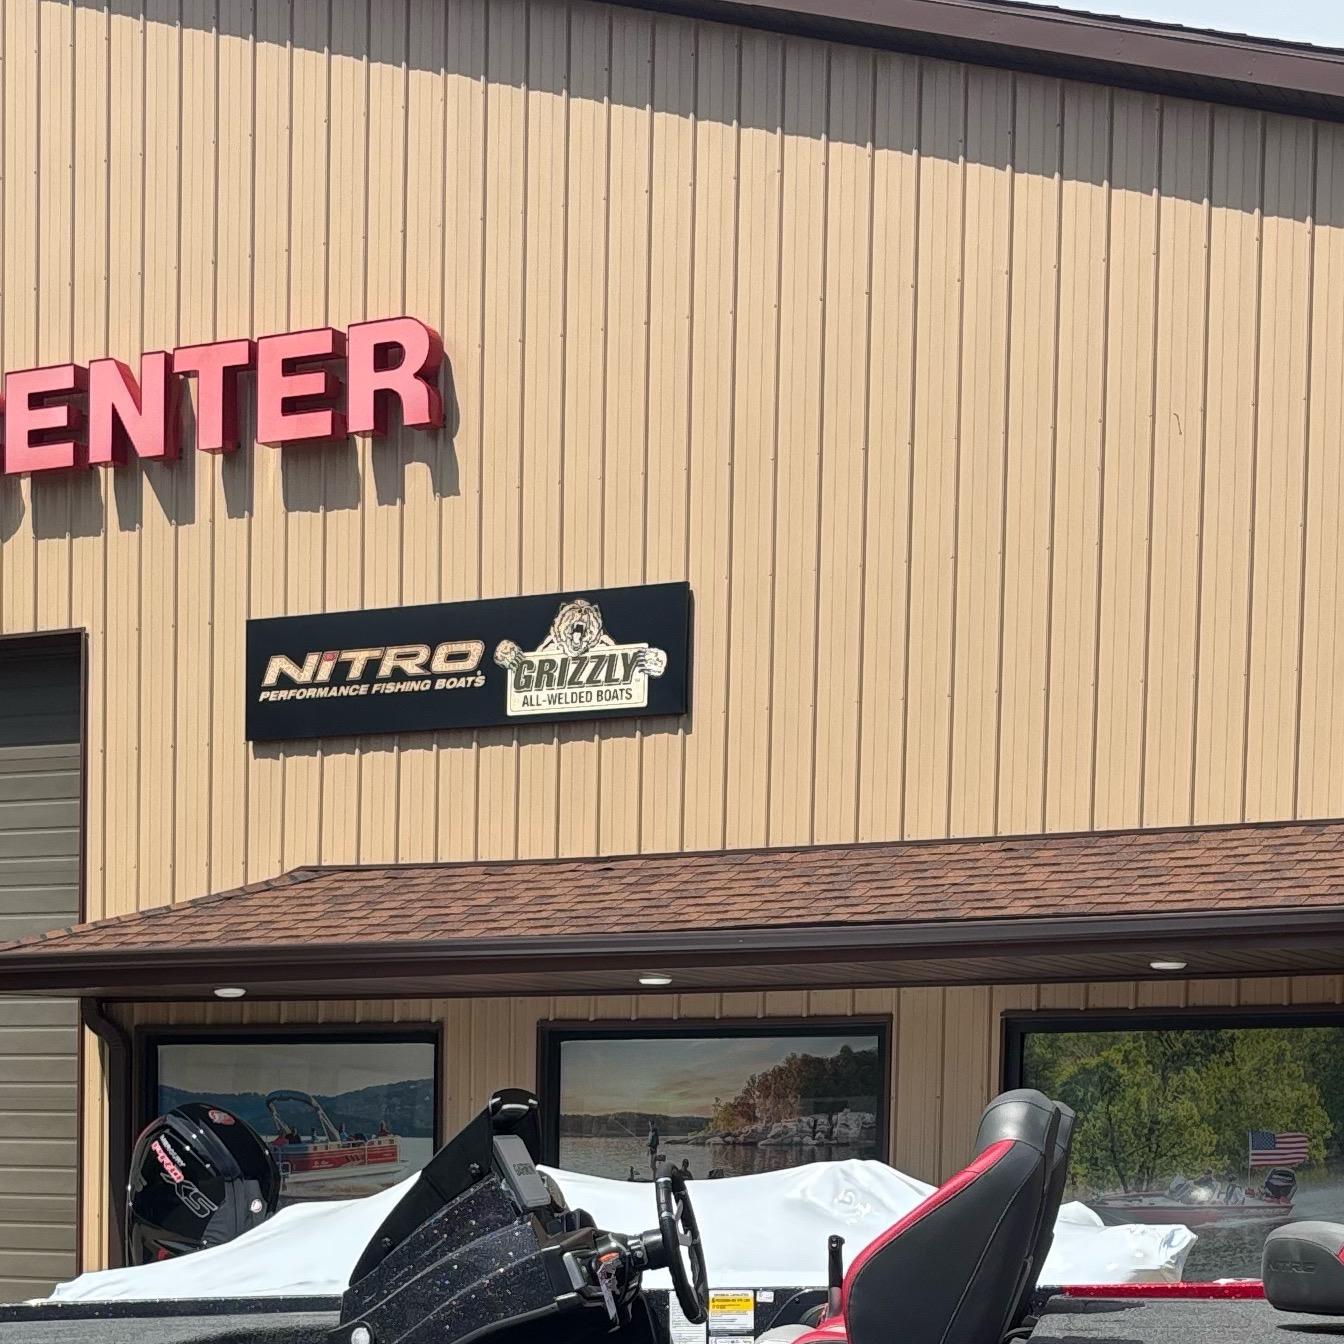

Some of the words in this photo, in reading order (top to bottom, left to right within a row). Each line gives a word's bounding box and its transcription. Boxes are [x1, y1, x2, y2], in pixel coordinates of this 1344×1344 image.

[513, 652, 638, 693] GRIZZLY
[259, 683, 369, 702] PERFORMANCE
[371, 678, 432, 695] FISHING
[434, 675, 486, 691] BOATS
[522, 690, 593, 708] ALL-WELDED
[596, 688, 633, 703] BOATS
